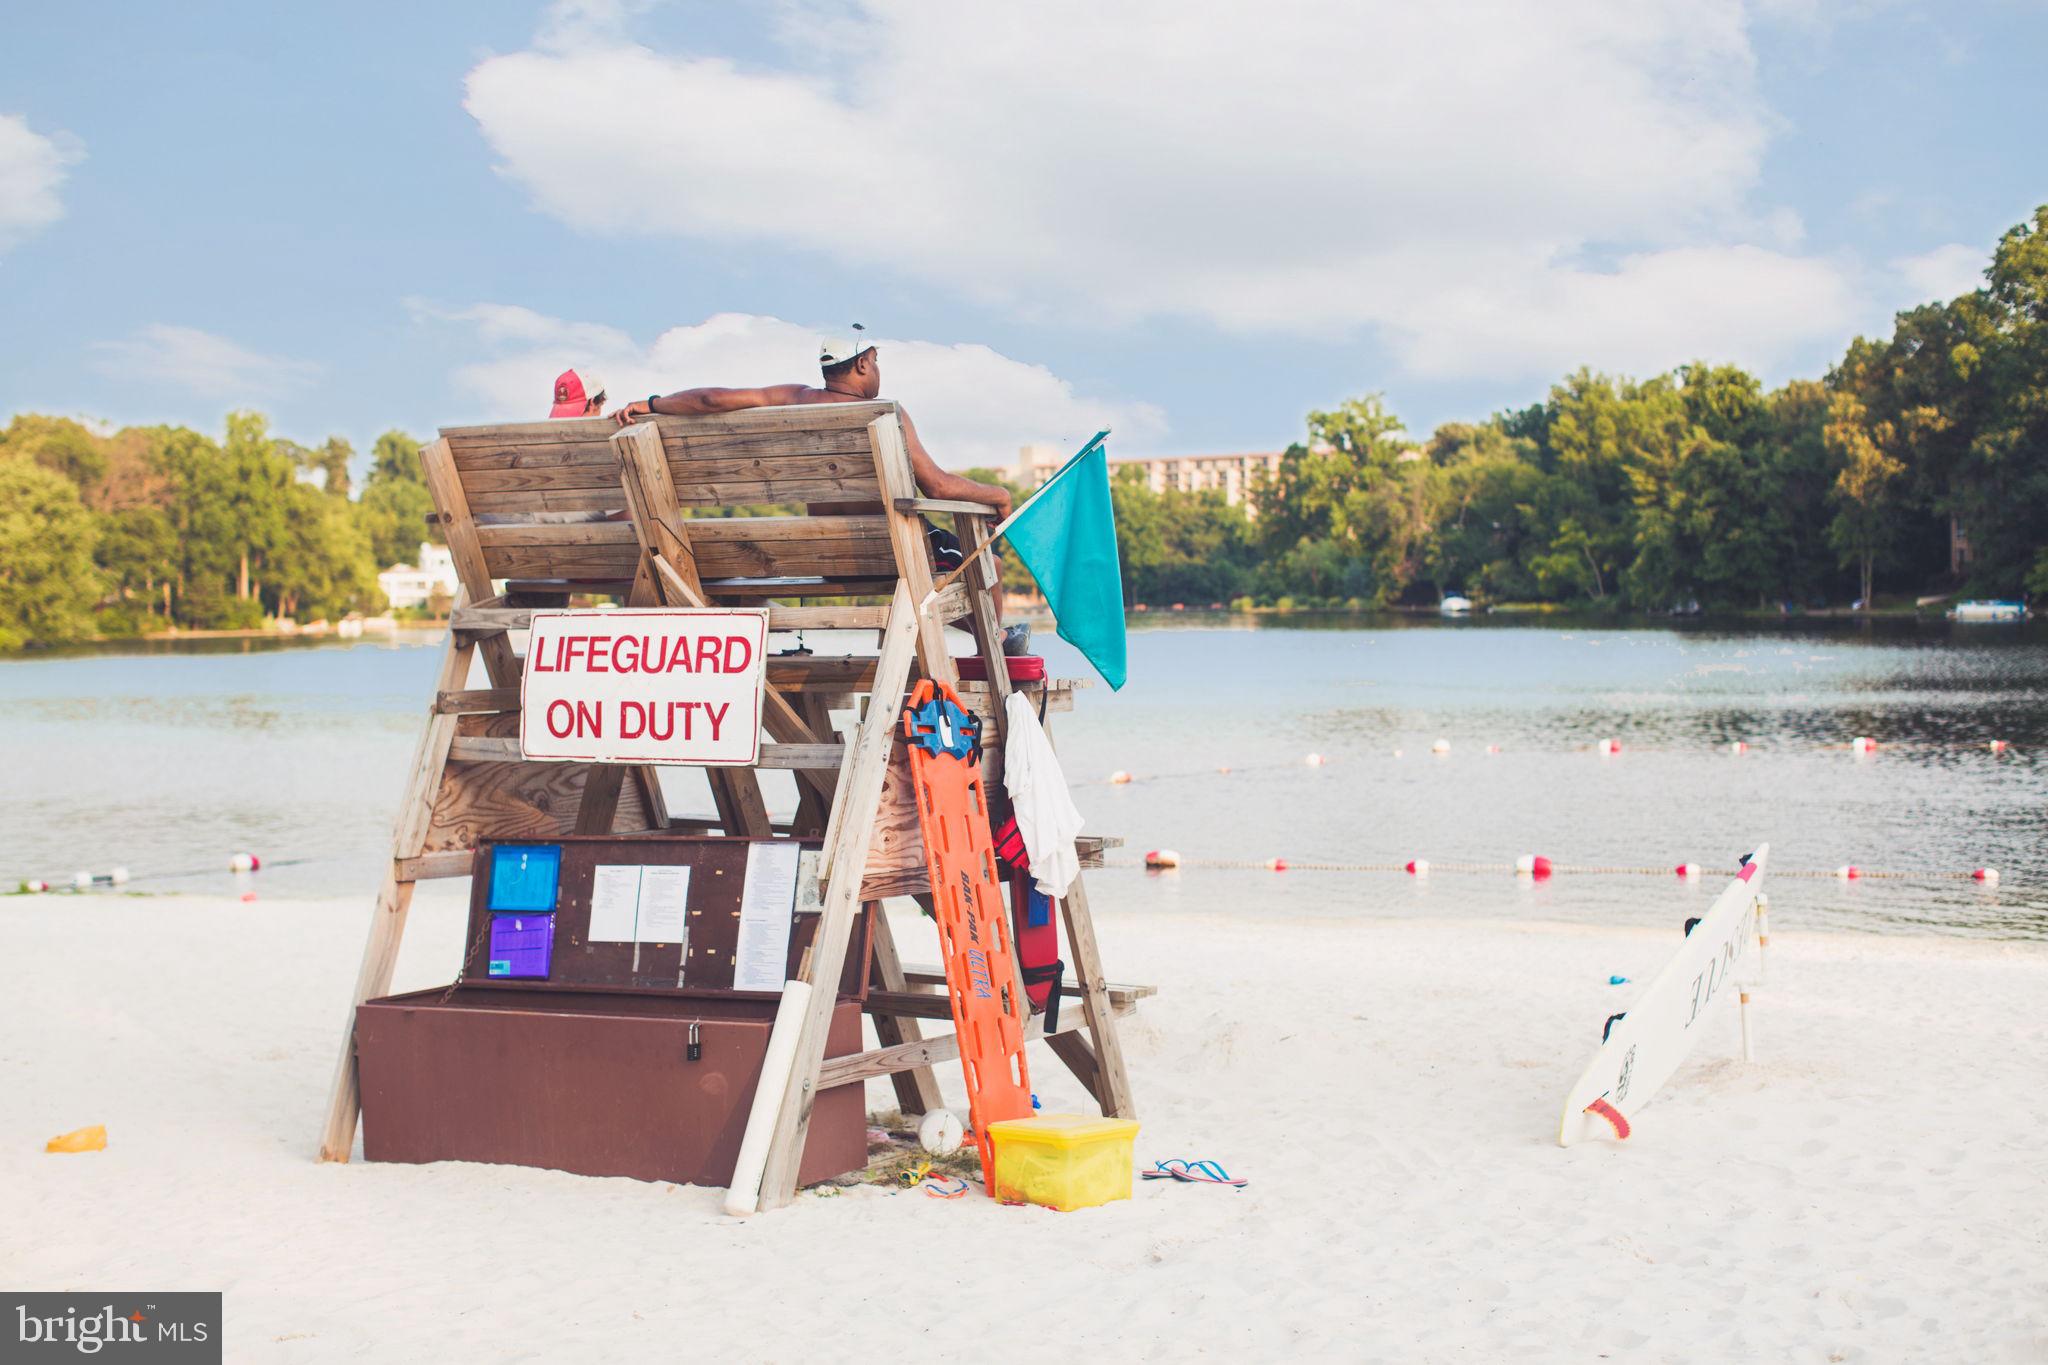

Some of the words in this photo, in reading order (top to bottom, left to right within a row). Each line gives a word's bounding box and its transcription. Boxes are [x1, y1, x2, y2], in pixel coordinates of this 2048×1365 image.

[534, 634, 751, 674] LIFEGUARD
[546, 699, 603, 739] ON
[620, 701, 730, 741] DUTY
[968, 948, 992, 999] ULTRA
